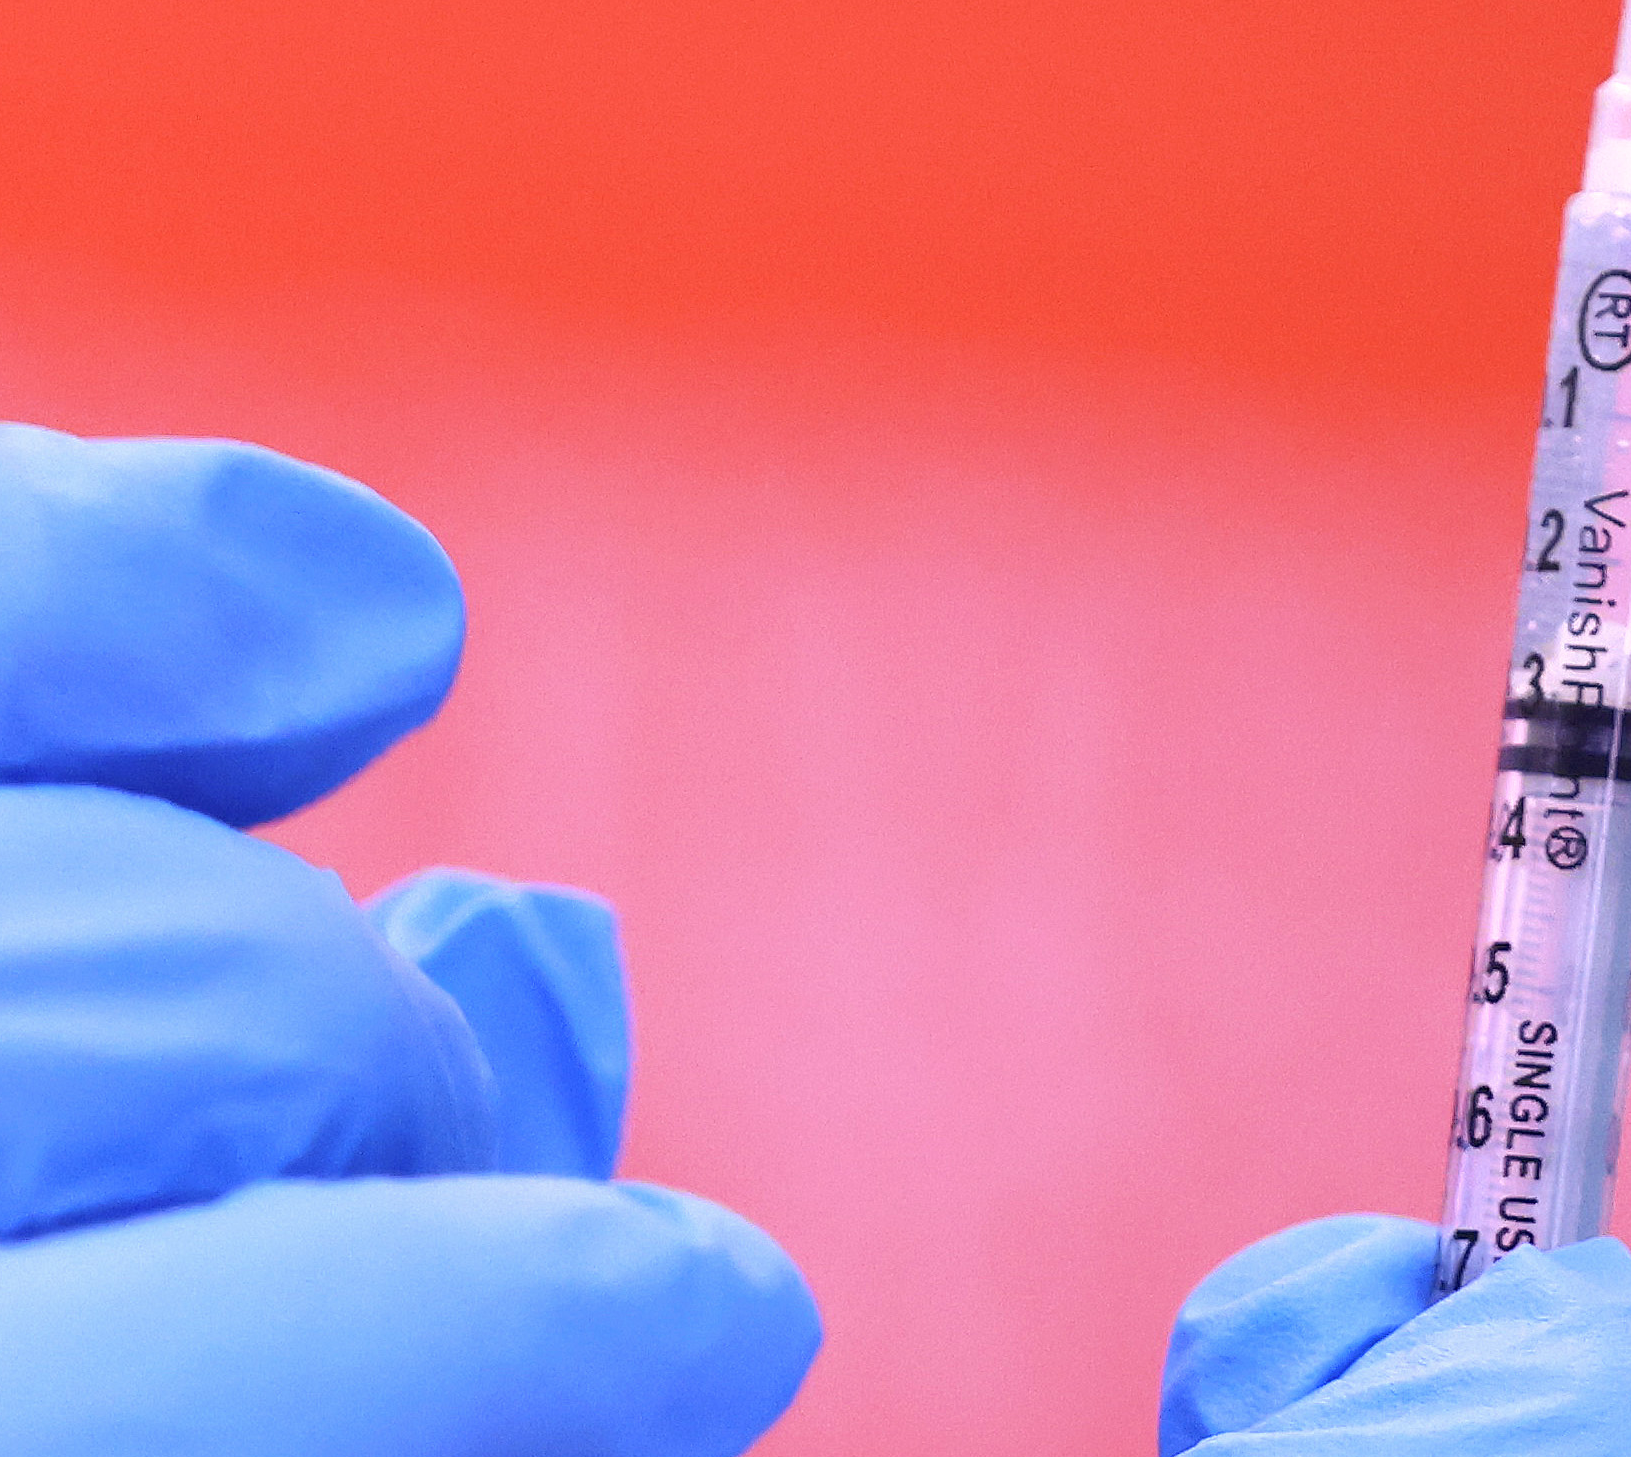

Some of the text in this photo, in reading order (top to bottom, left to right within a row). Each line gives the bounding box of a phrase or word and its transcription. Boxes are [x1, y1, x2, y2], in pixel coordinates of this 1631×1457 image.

[1544, 490, 1630, 871] VanishPnt®
[1493, 1019, 1558, 1264] SINGLE US
